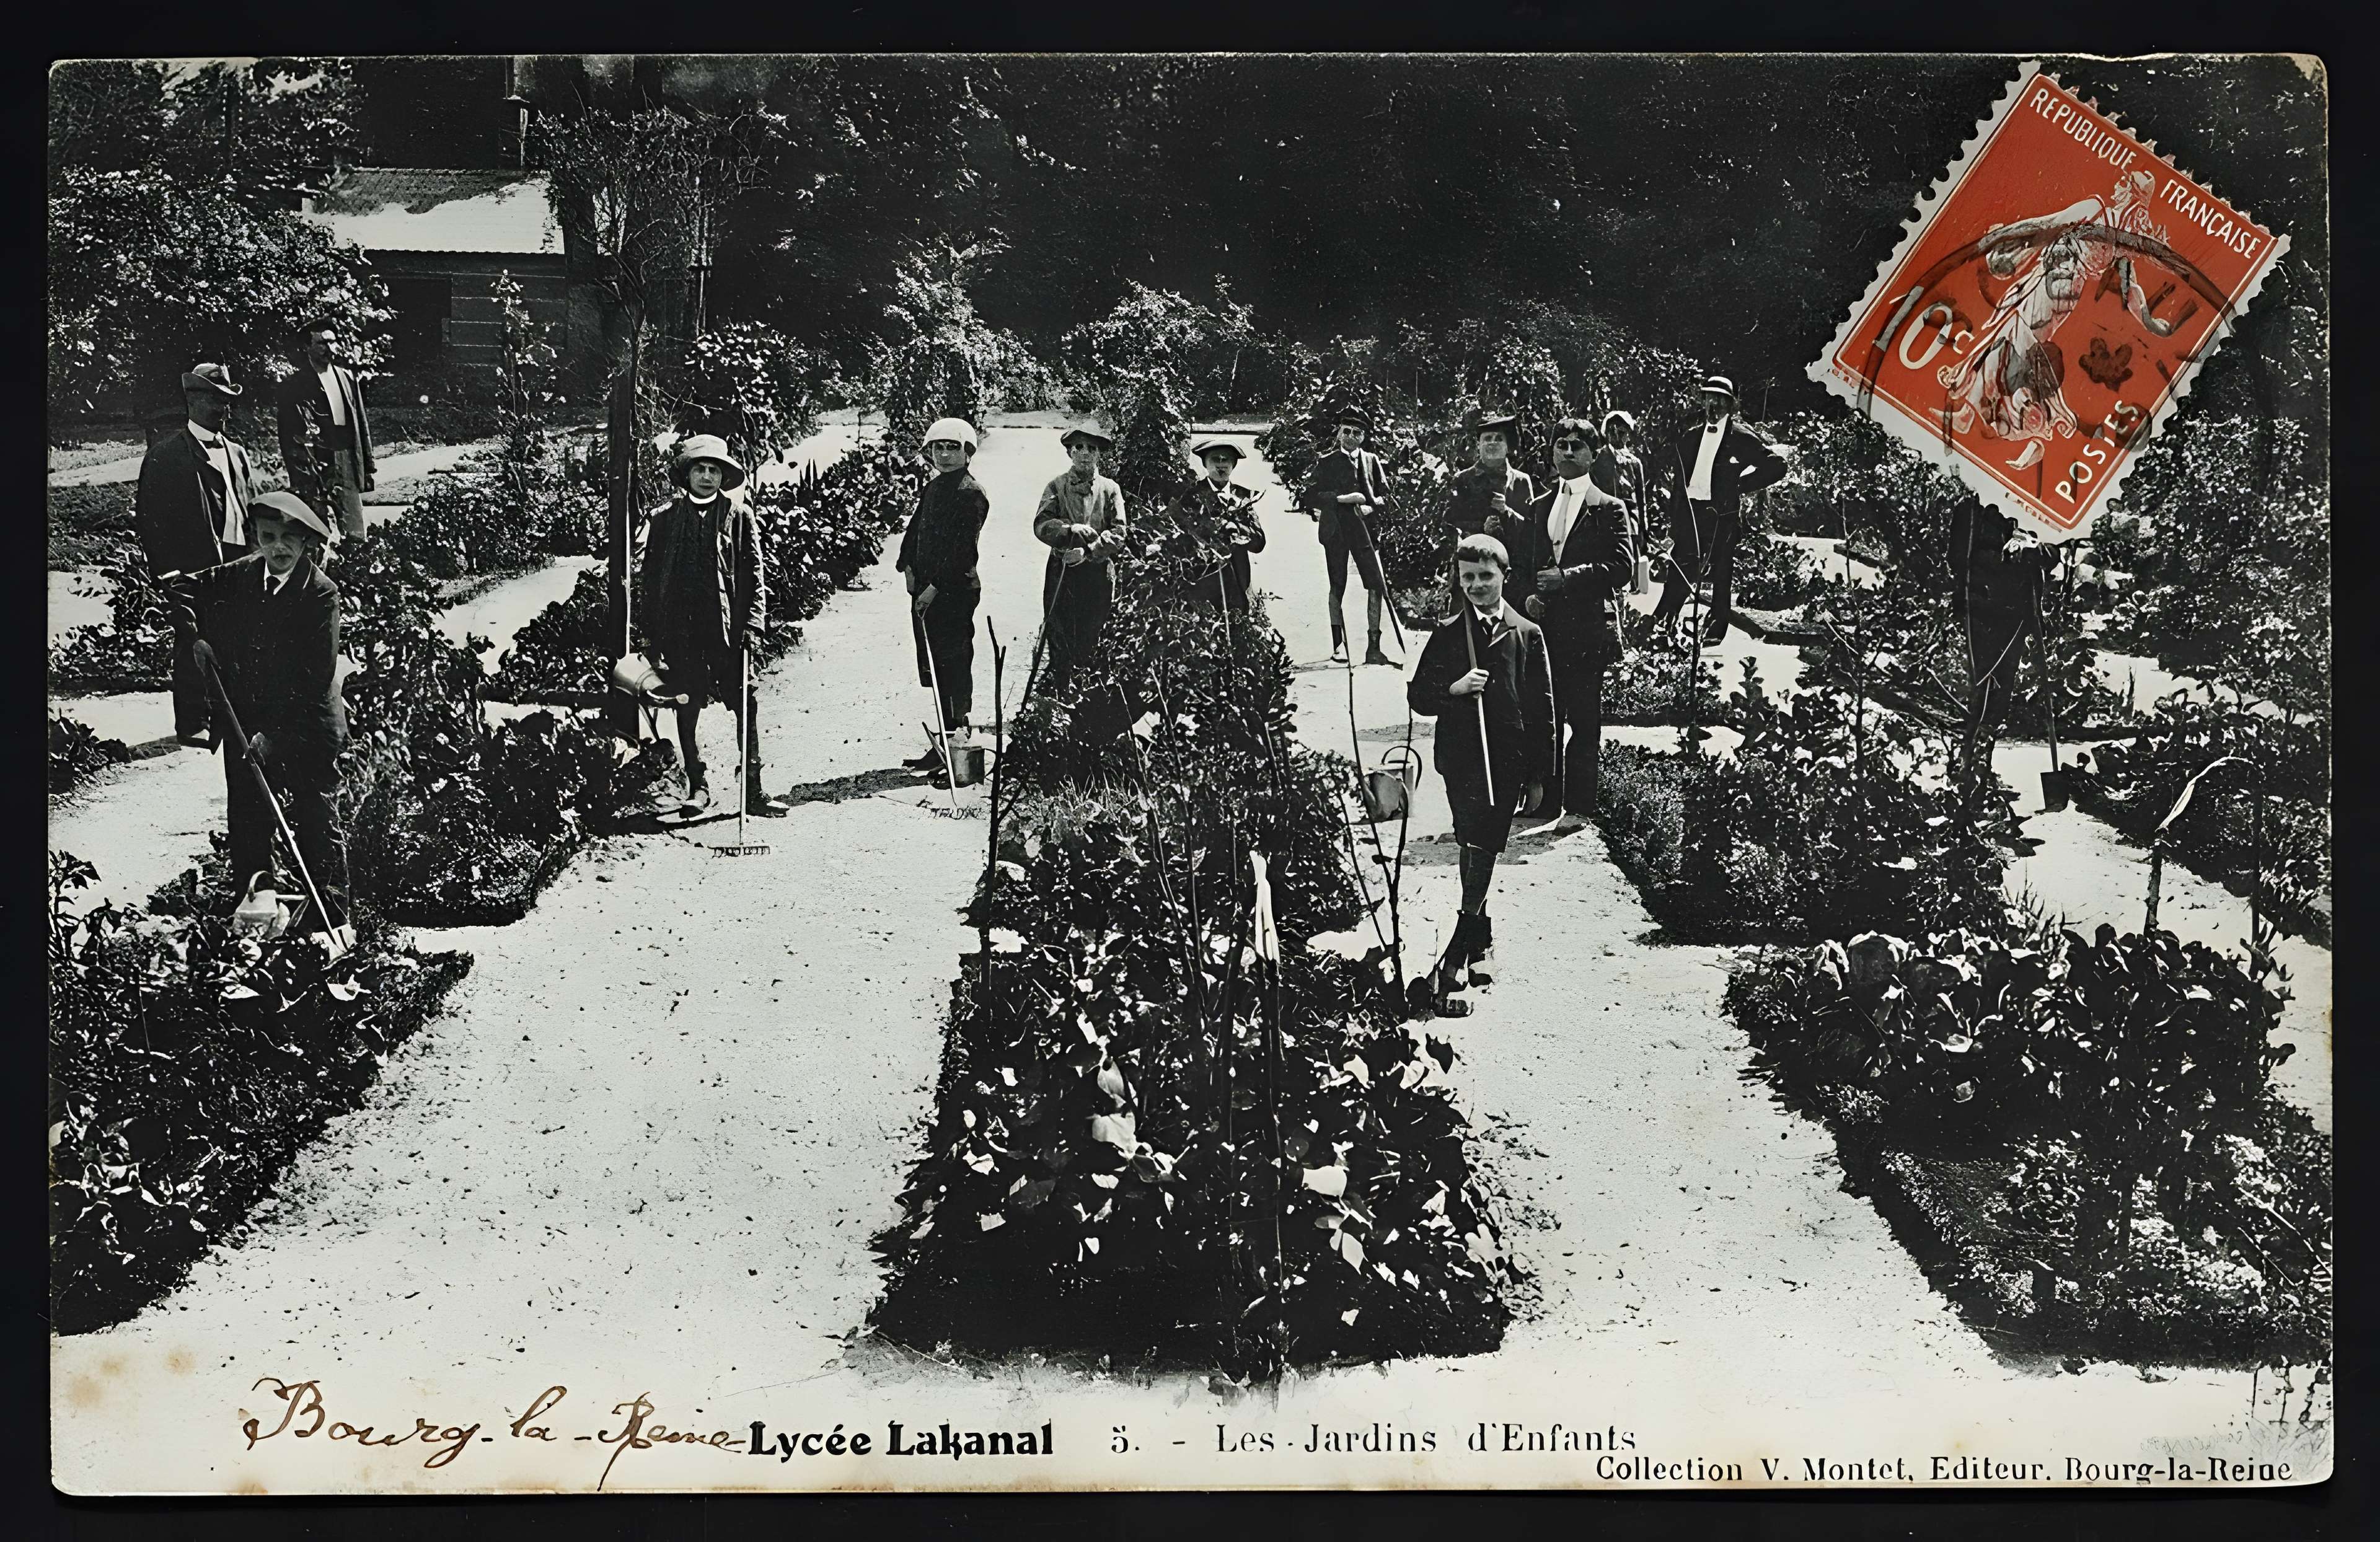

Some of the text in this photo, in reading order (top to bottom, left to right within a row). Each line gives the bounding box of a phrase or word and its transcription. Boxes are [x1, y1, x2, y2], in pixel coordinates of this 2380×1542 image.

[2159, 178, 2262, 260] FRANÇAISE
[747, 1420, 873, 1463] Lycée
[885, 1417, 1054, 1461] Lakanal
[1212, 1423, 1275, 1453] Les
[1304, 1422, 1437, 1453] Jardins
[1468, 1422, 1636, 1453] d'Enfants
[1596, 1455, 1742, 1481] Collection
[1759, 1456, 1789, 1482] V.
[1929, 1455, 2052, 1482] Editeur.
